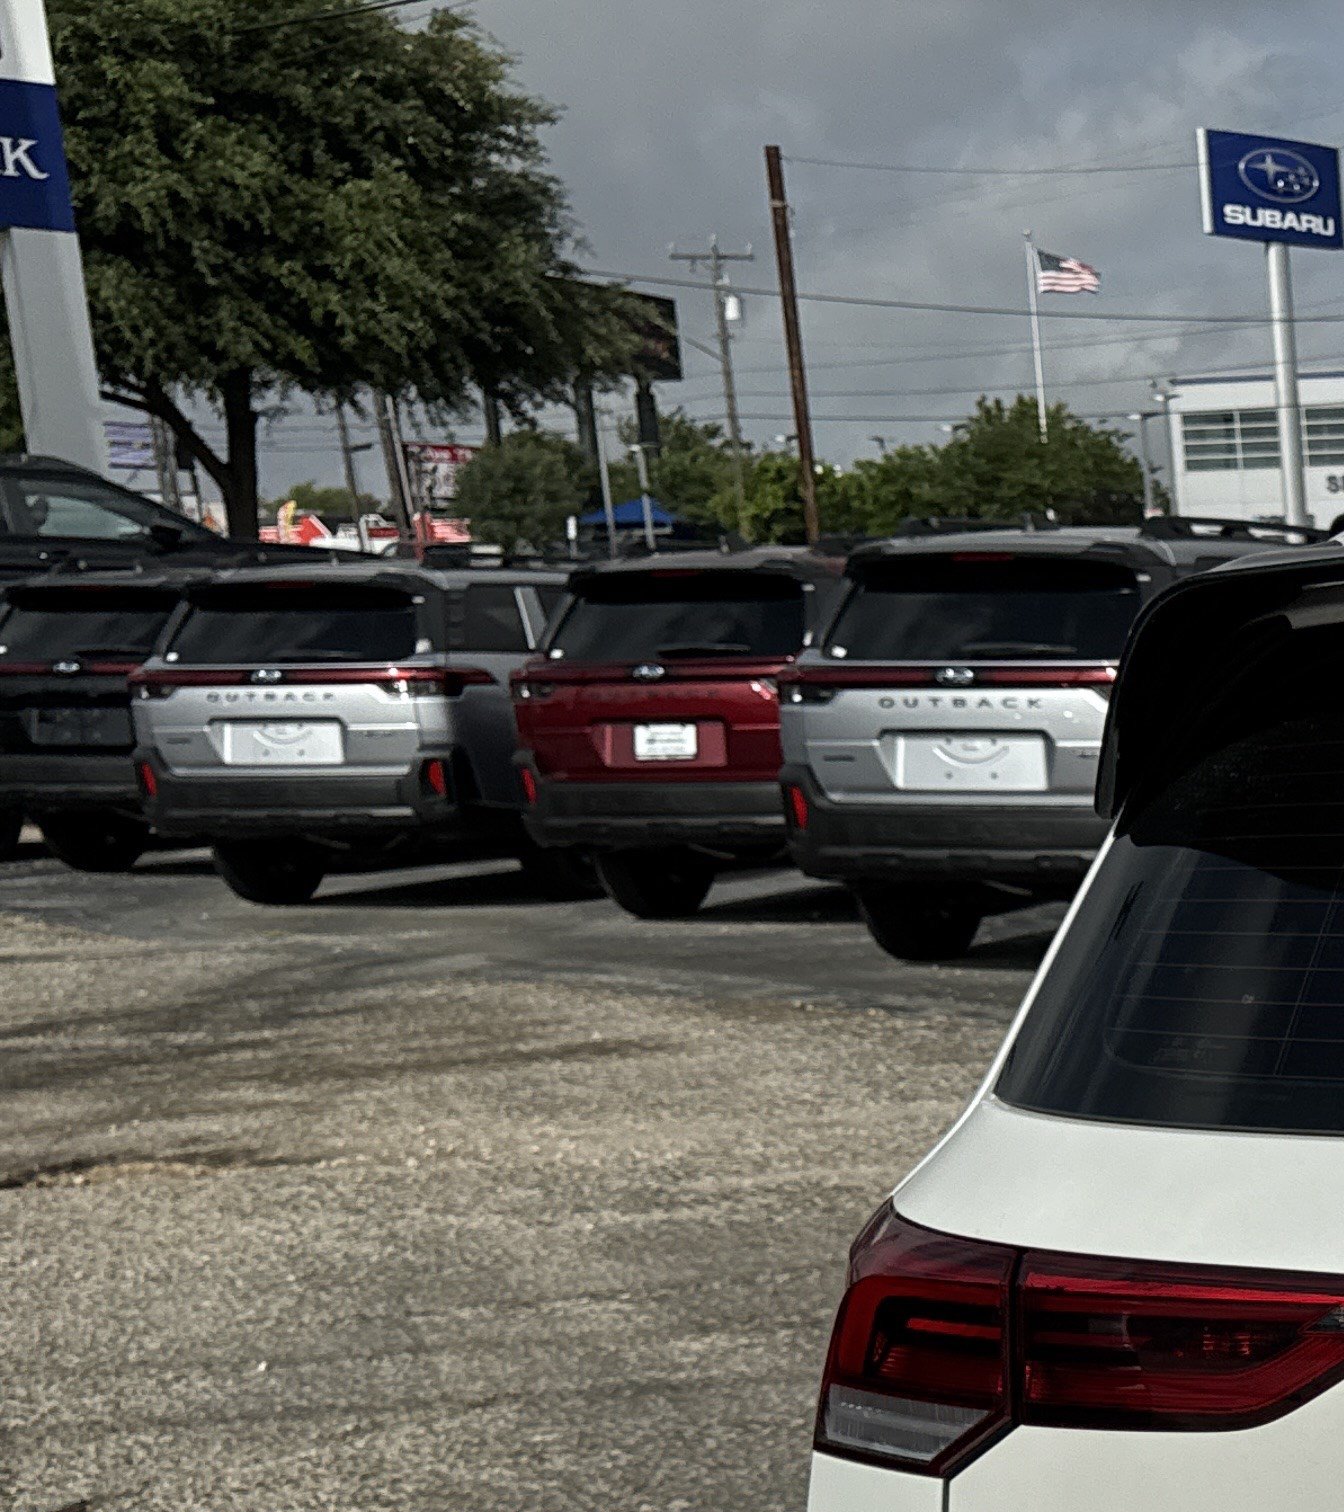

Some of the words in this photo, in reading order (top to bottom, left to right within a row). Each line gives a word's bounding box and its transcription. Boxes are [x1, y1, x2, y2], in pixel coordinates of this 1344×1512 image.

[0, 137, 50, 180] K
[1223, 203, 1336, 238] SUBARU
[877, 695, 1043, 710] OUTBACK
